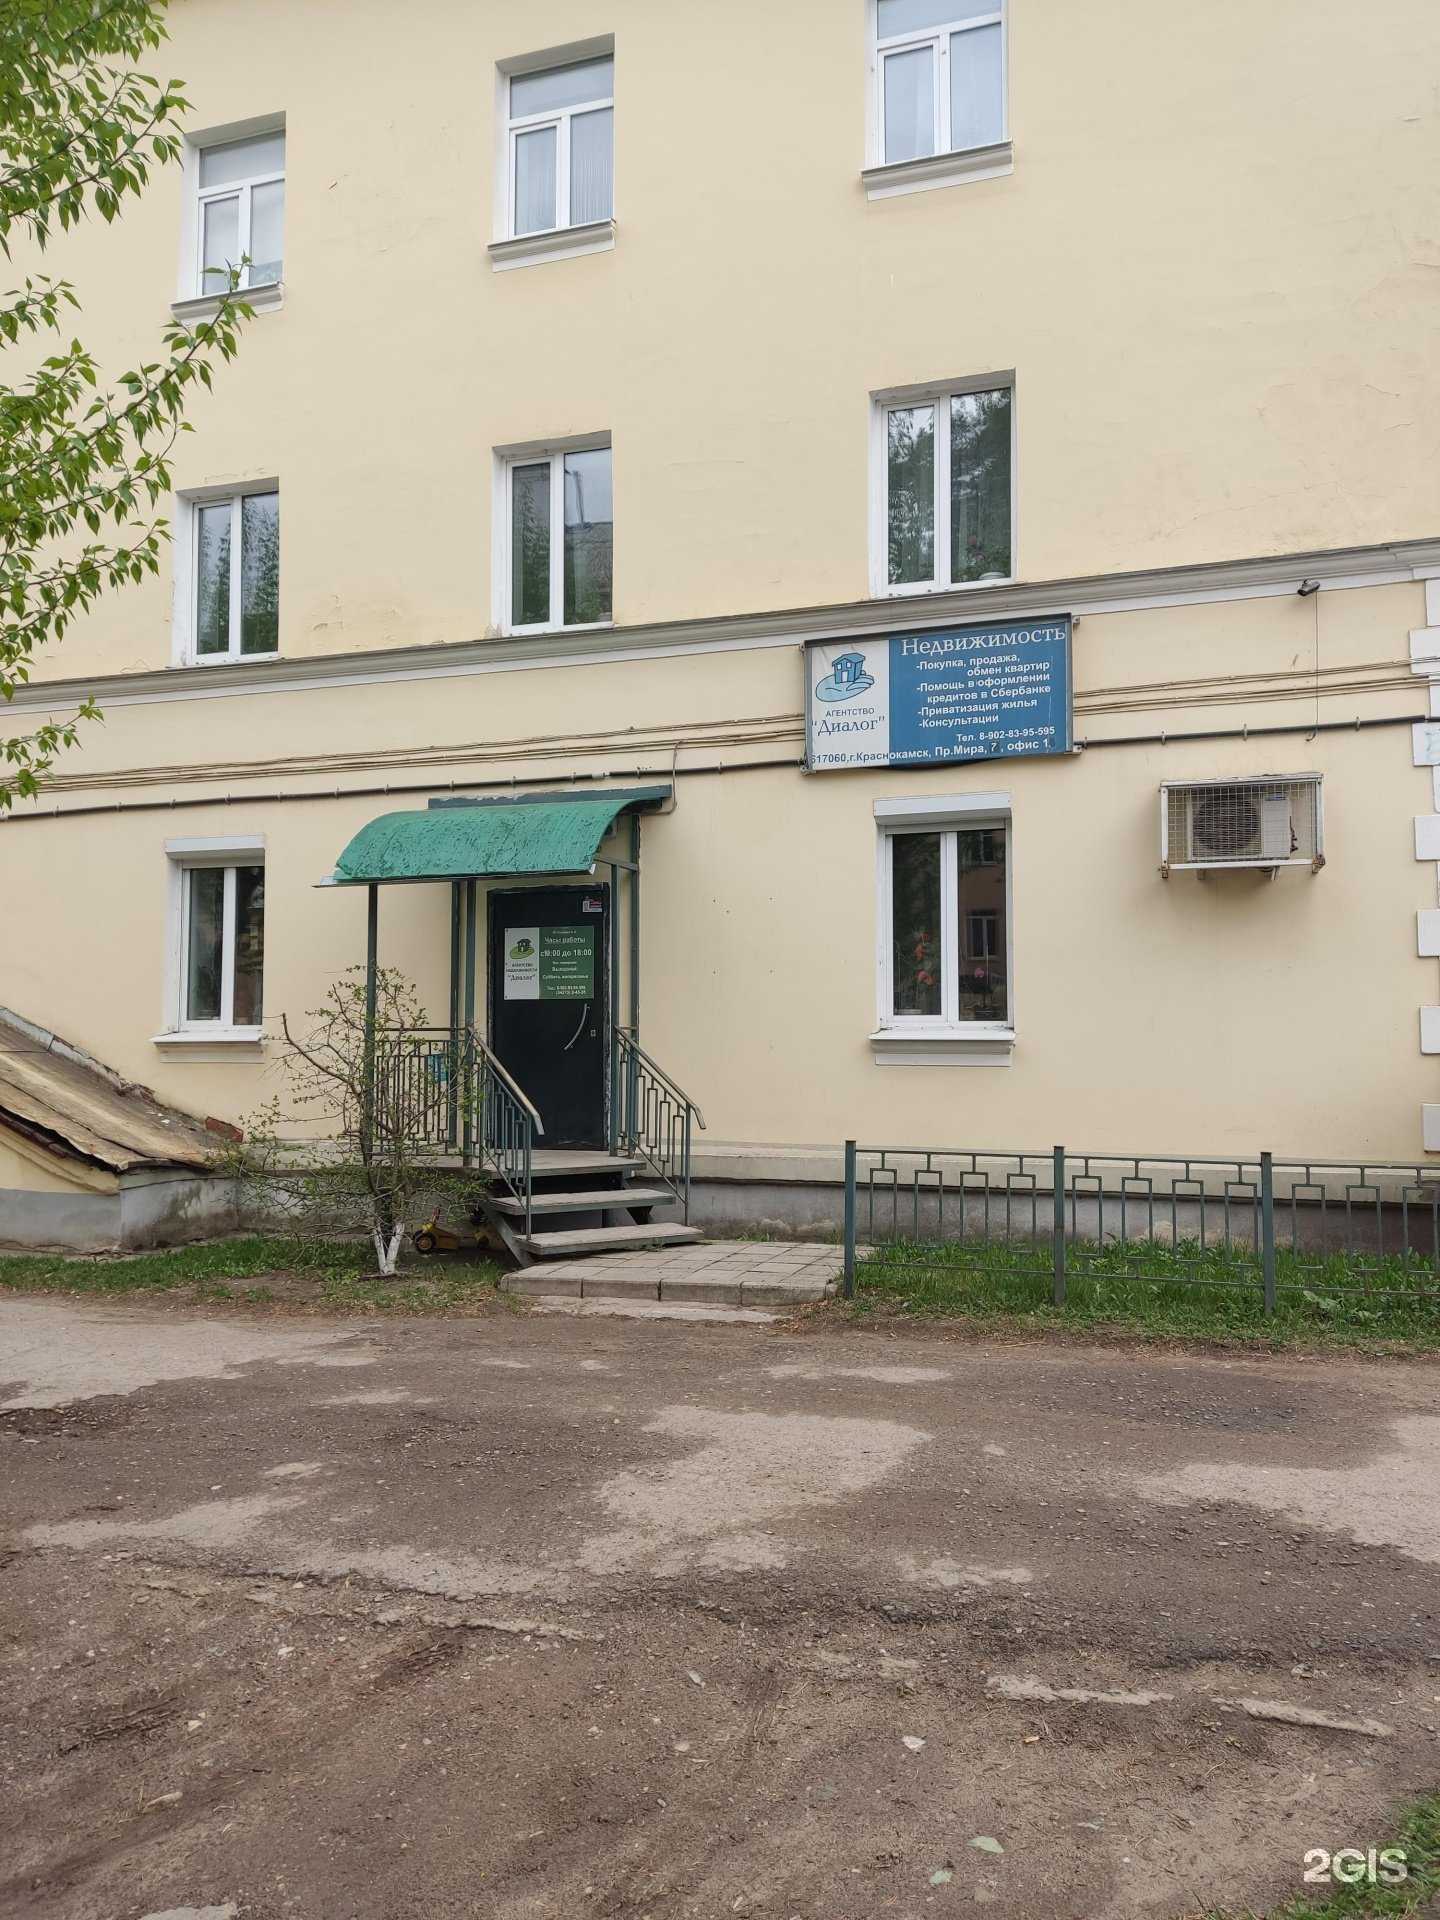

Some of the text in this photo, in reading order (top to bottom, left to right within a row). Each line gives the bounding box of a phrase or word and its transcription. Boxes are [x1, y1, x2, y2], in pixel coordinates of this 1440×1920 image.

[901, 627, 1066, 656] Недвижимость
[916, 653, 1020, 671] -Покупка, продажа,
[967, 661, 1050, 677] обмен квартир
[916, 673, 1050, 692] -Помощь в оформлении
[927, 685, 1051, 705] кредитов в Сбербанке
[825, 707, 875, 718] АГЕНТСТВО
[917, 698, 1038, 718] -Приватизация жилья
[811, 715, 885, 736] "Диалог"
[918, 714, 999, 729] -Консультации
[956, 726, 1056, 743] Тел. 8-902-83-95-595
[935, 744, 988, 757] Пр.Мира,
[1007, 739, 1040, 752] офис
